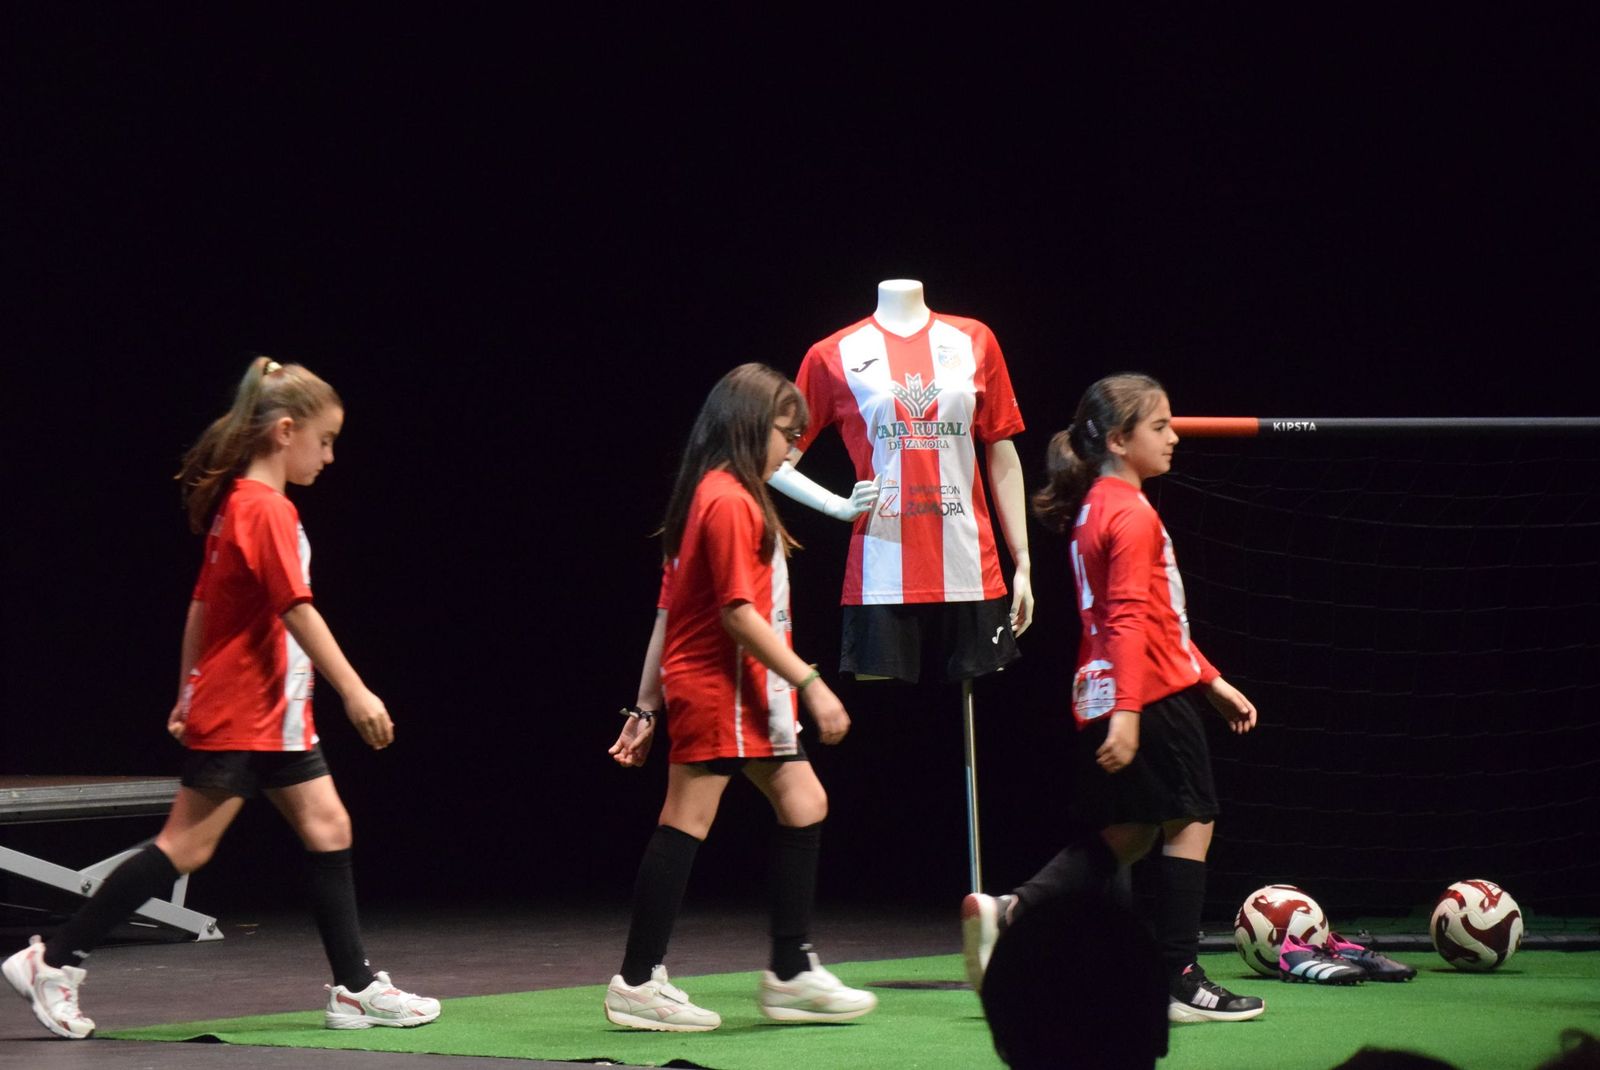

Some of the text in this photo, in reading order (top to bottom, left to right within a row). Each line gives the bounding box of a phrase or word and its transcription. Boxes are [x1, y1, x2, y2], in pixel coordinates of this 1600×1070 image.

[911, 422, 966, 436] RURAL
[1273, 422, 1317, 431] KIPSTA
[888, 439, 949, 450] DE ZAMORA
